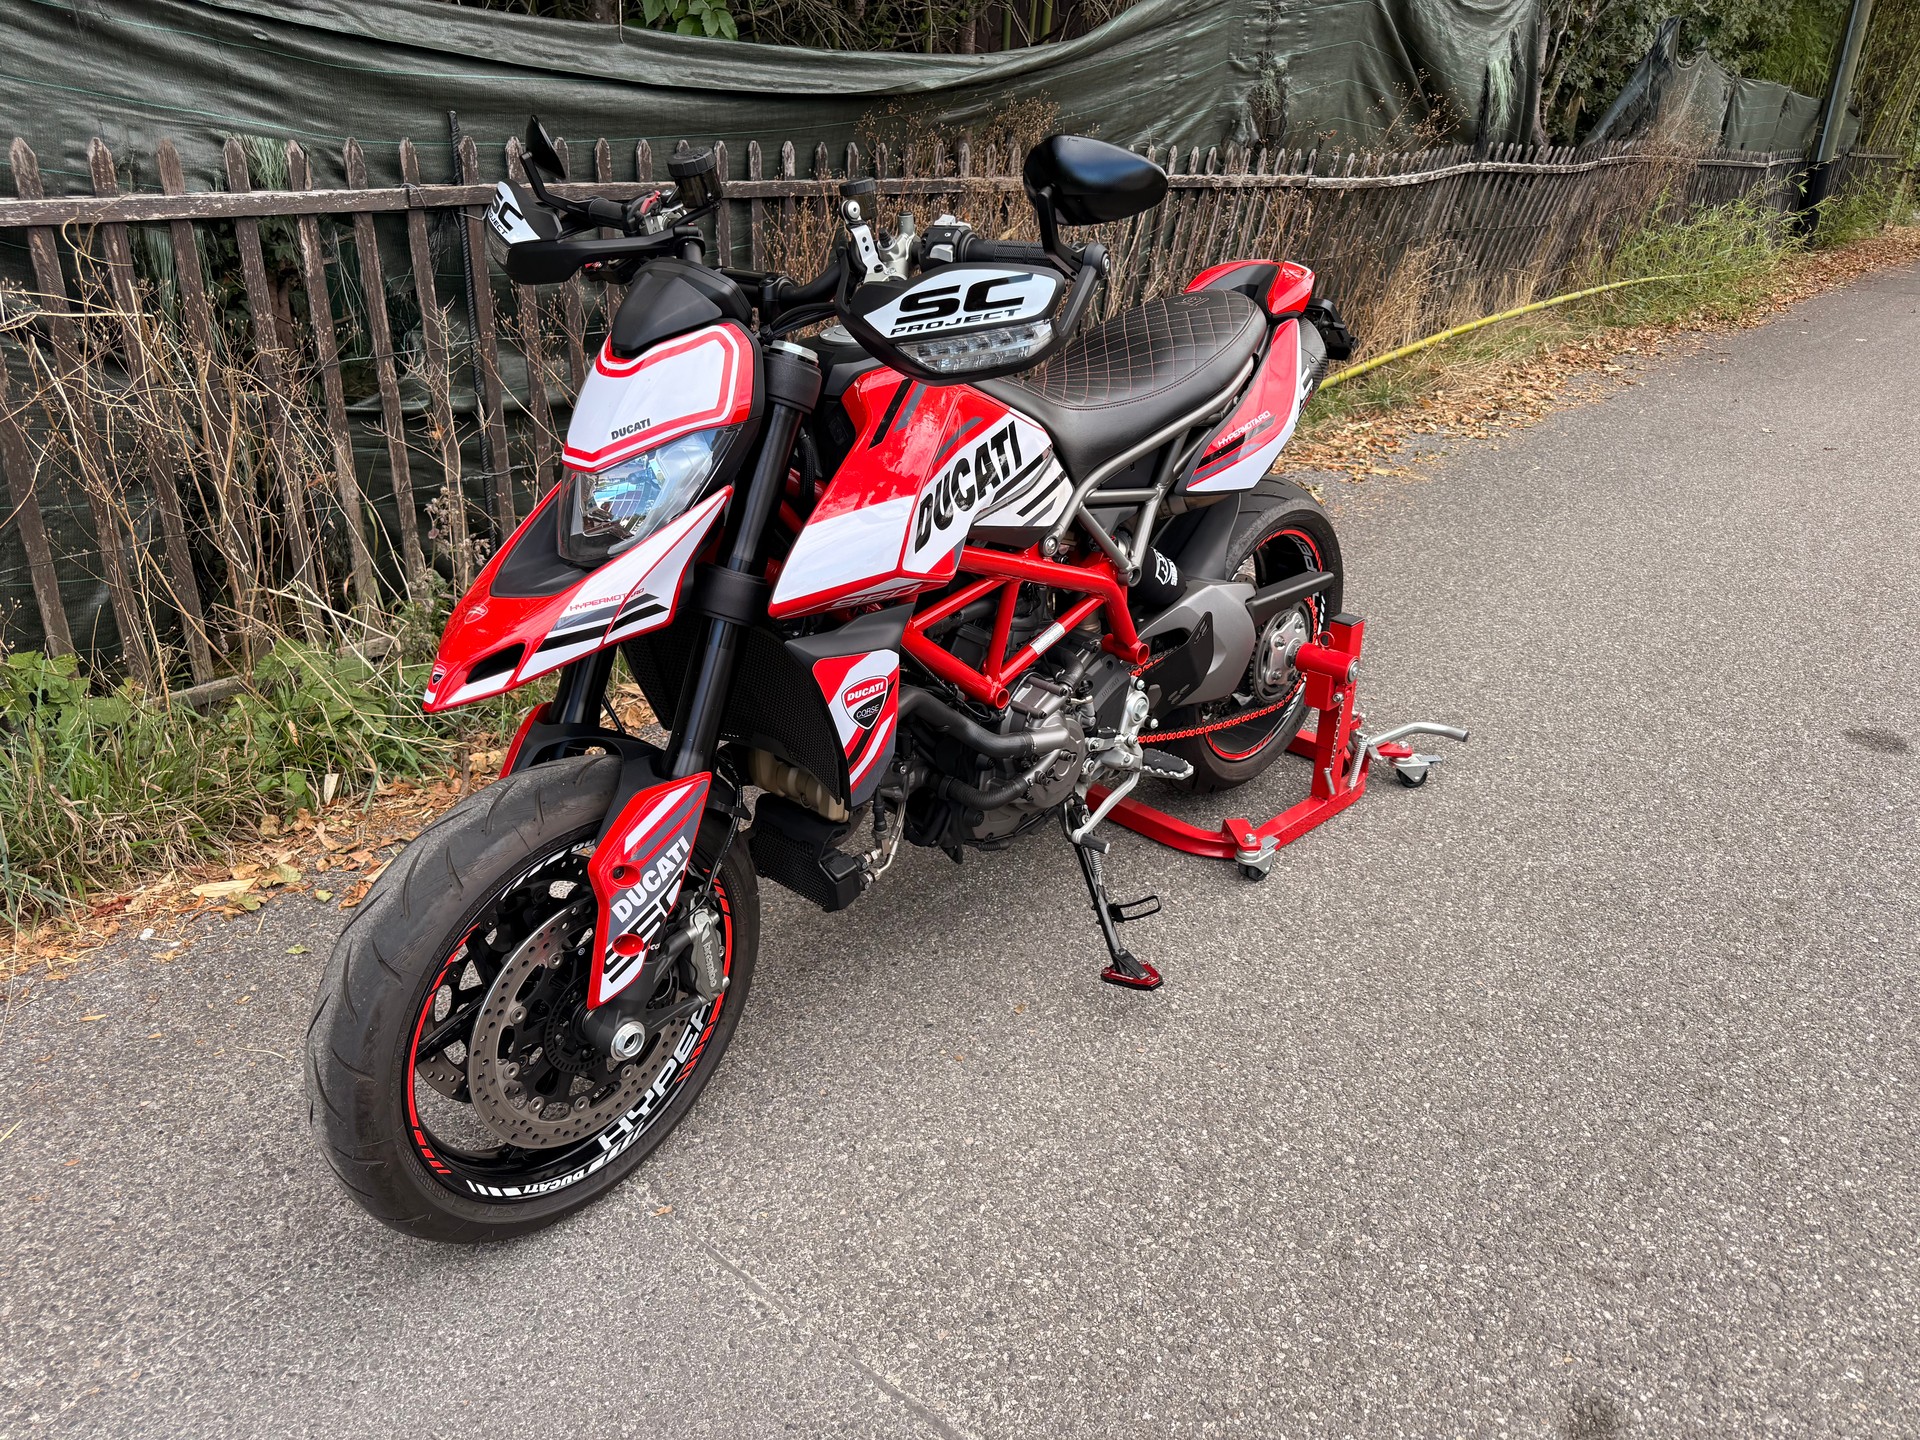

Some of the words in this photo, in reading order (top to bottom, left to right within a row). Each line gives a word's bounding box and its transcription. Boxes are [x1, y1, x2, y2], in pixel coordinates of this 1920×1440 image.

[895, 273, 1034, 326] SC
[890, 308, 1022, 336] PROJECT
[611, 418, 651, 441] DUCATI
[1218, 410, 1271, 448] HYPERMOTARD
[914, 420, 1023, 555] DUCATI
[847, 681, 885, 702] DUCATI
[856, 704, 880, 719] CORSE
[611, 835, 691, 924] DUCATI
[703, 940, 718, 988] brembo
[523, 1172, 586, 1194] DUCATI
